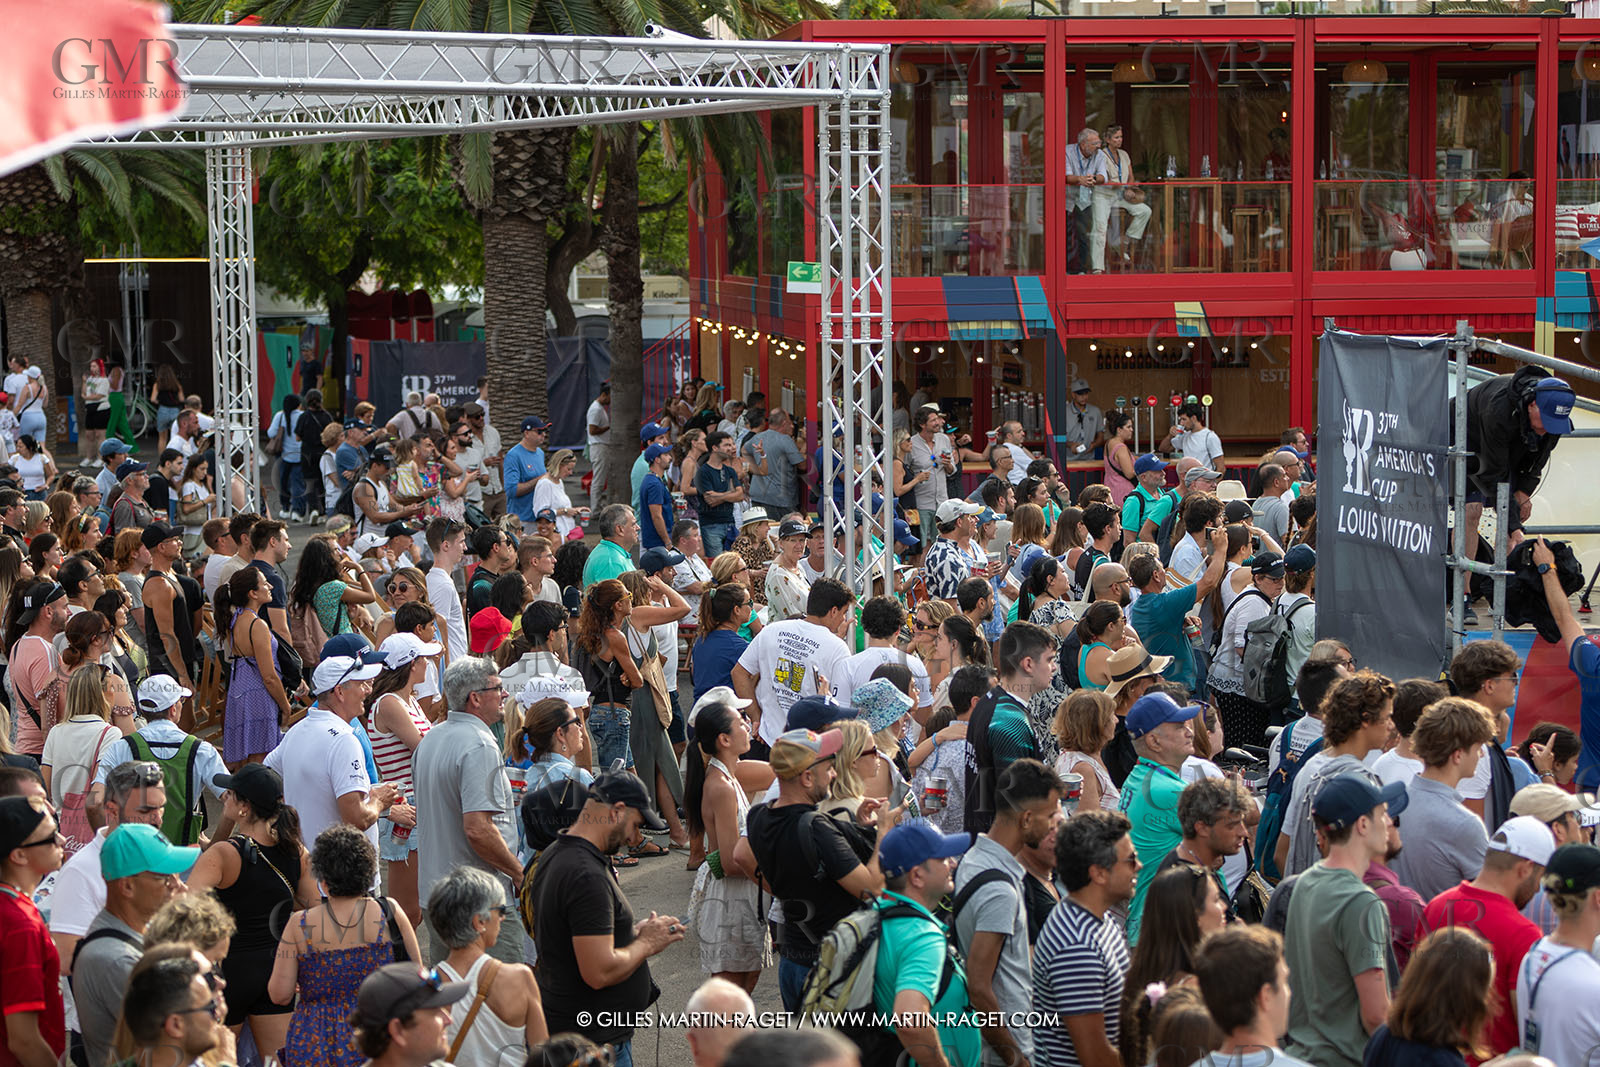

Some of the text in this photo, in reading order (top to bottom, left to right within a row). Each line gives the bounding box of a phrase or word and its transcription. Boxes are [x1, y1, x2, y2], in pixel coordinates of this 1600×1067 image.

[434, 375, 456, 384] 37TH
[440, 398, 456, 407] UP
[1375, 446, 1435, 477] AMERICA'S
[1372, 478, 1398, 504] CUP
[1338, 505, 1378, 542] LOUIS
[778, 632, 800, 641] ENRICO
[804, 638, 820, 649] SONS
